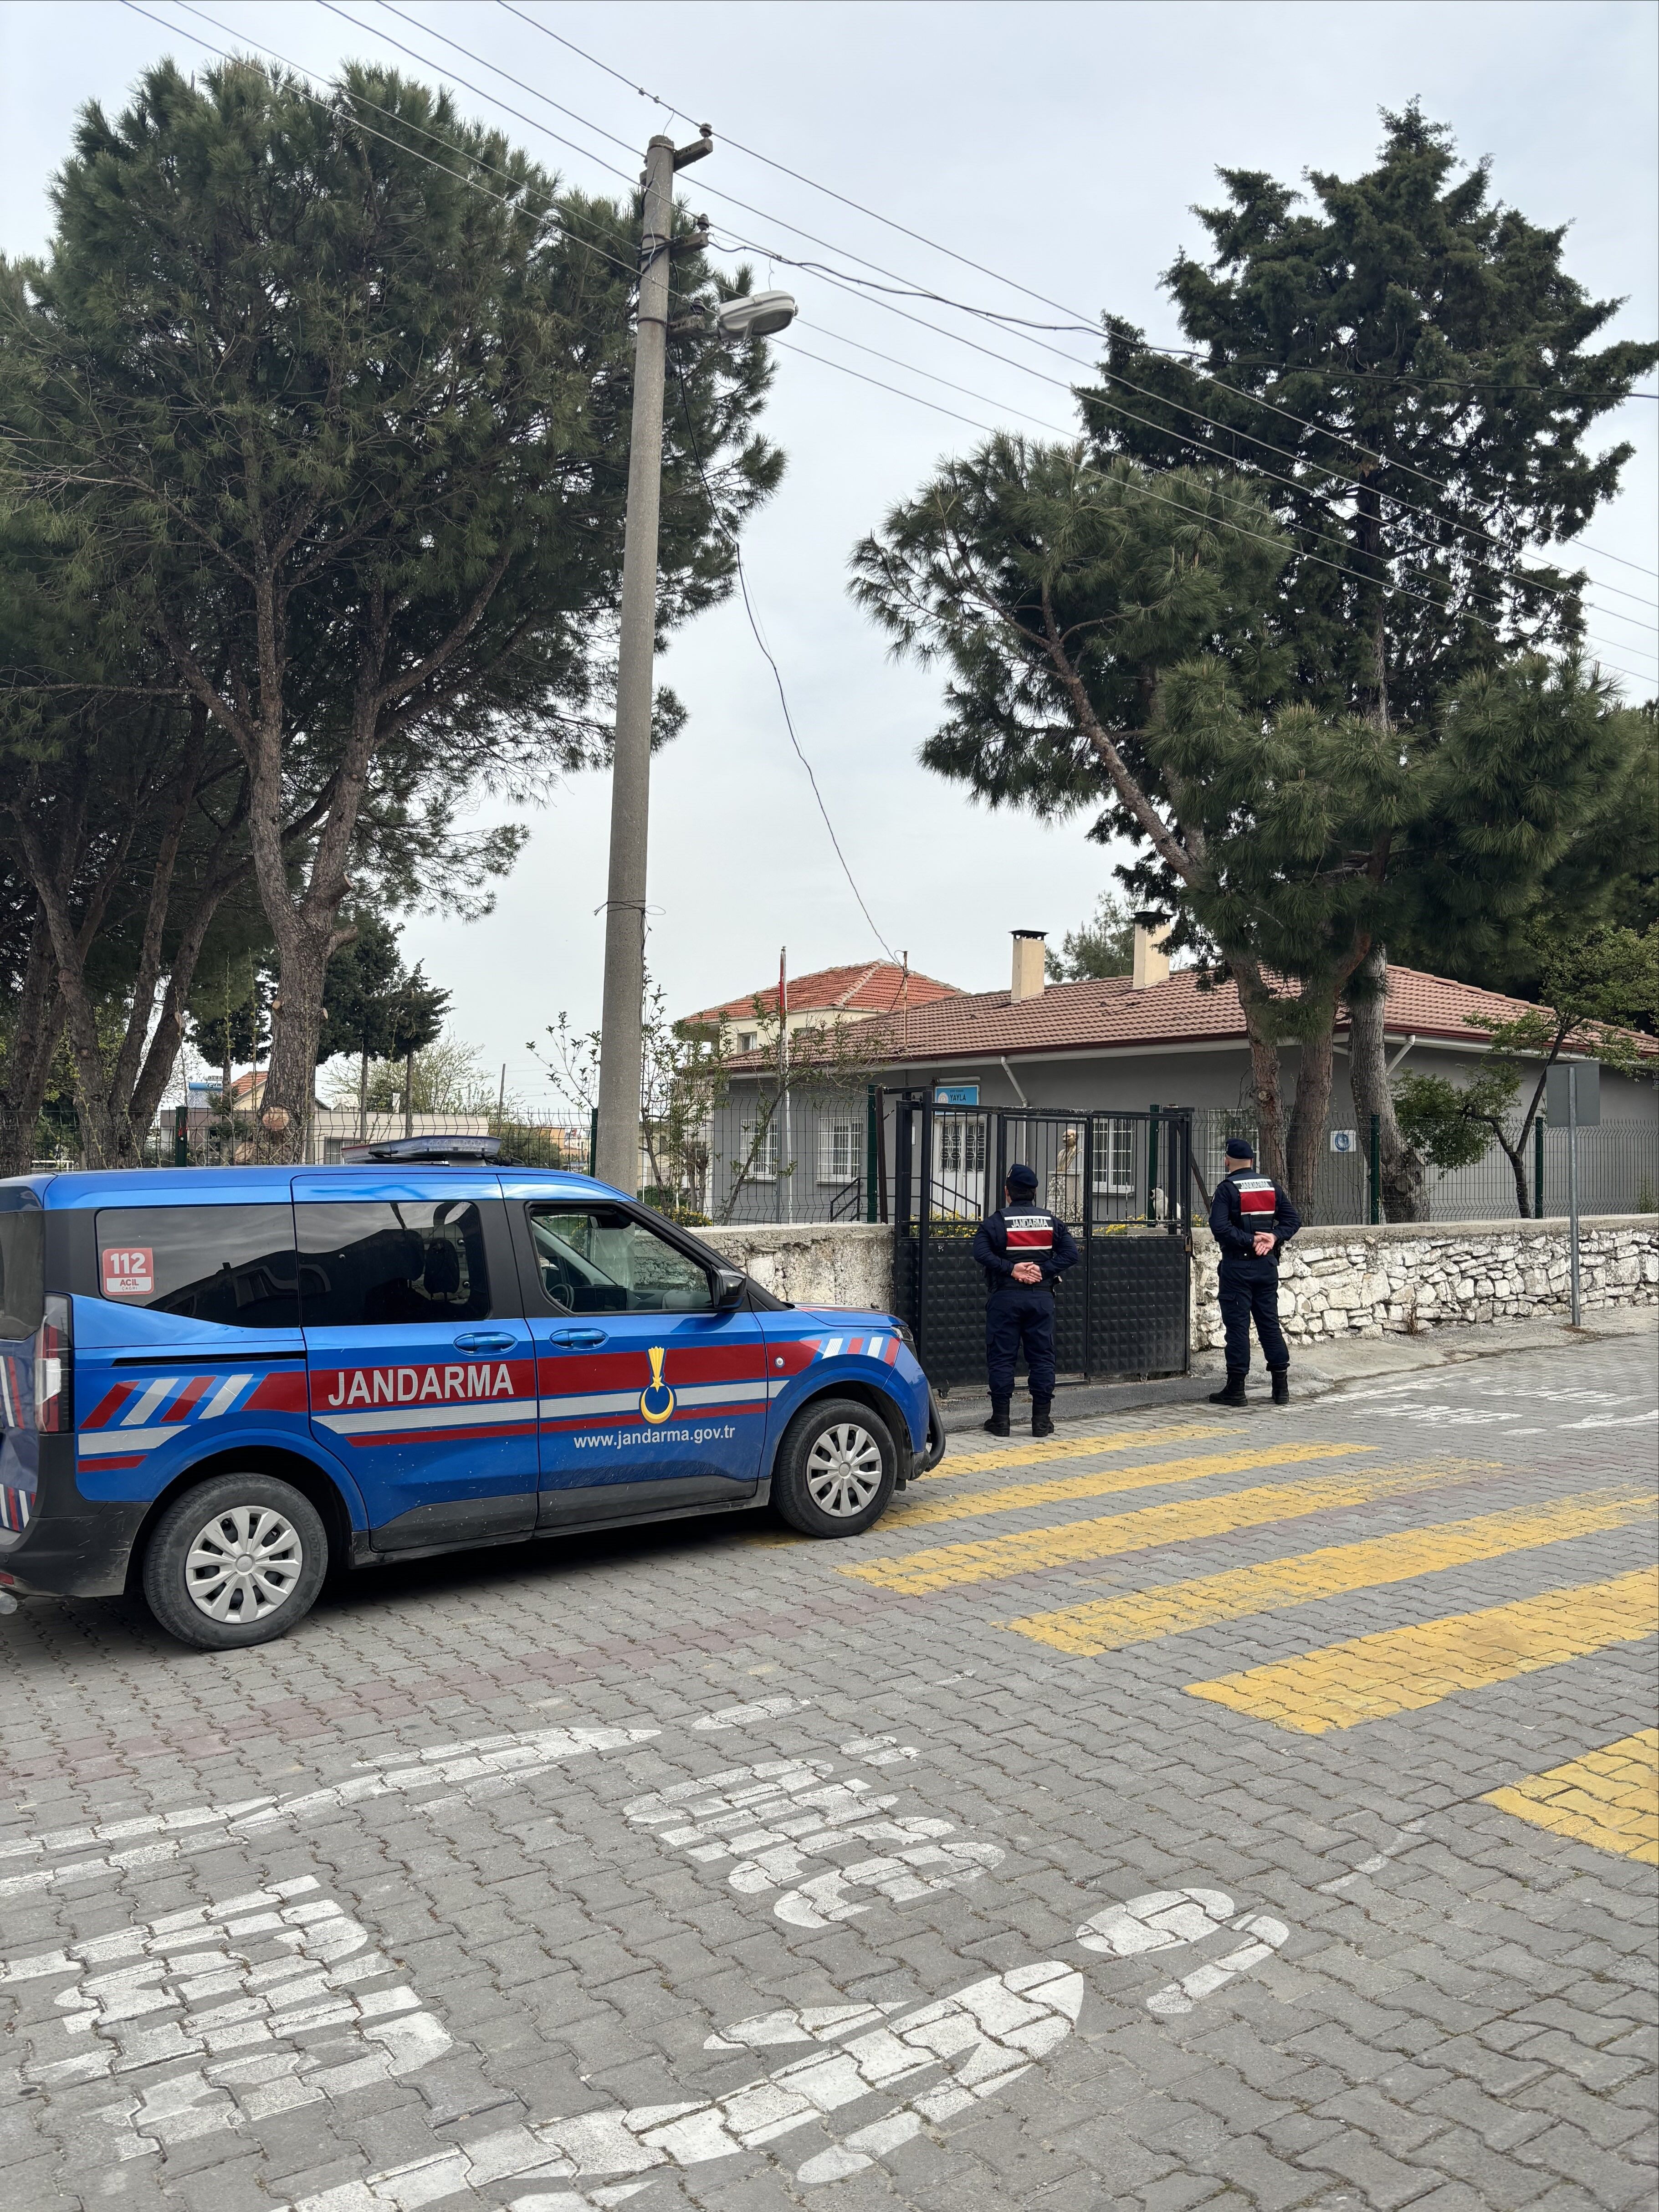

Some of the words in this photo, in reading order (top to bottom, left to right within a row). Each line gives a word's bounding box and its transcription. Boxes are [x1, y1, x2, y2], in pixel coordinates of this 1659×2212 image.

[1011, 1219, 1049, 1228] JANDARMA
[111, 1253, 146, 1274] 112
[328, 1364, 514, 1406] JANDARMA
[573, 1425, 735, 1449] www.jandarma.gov.tr
